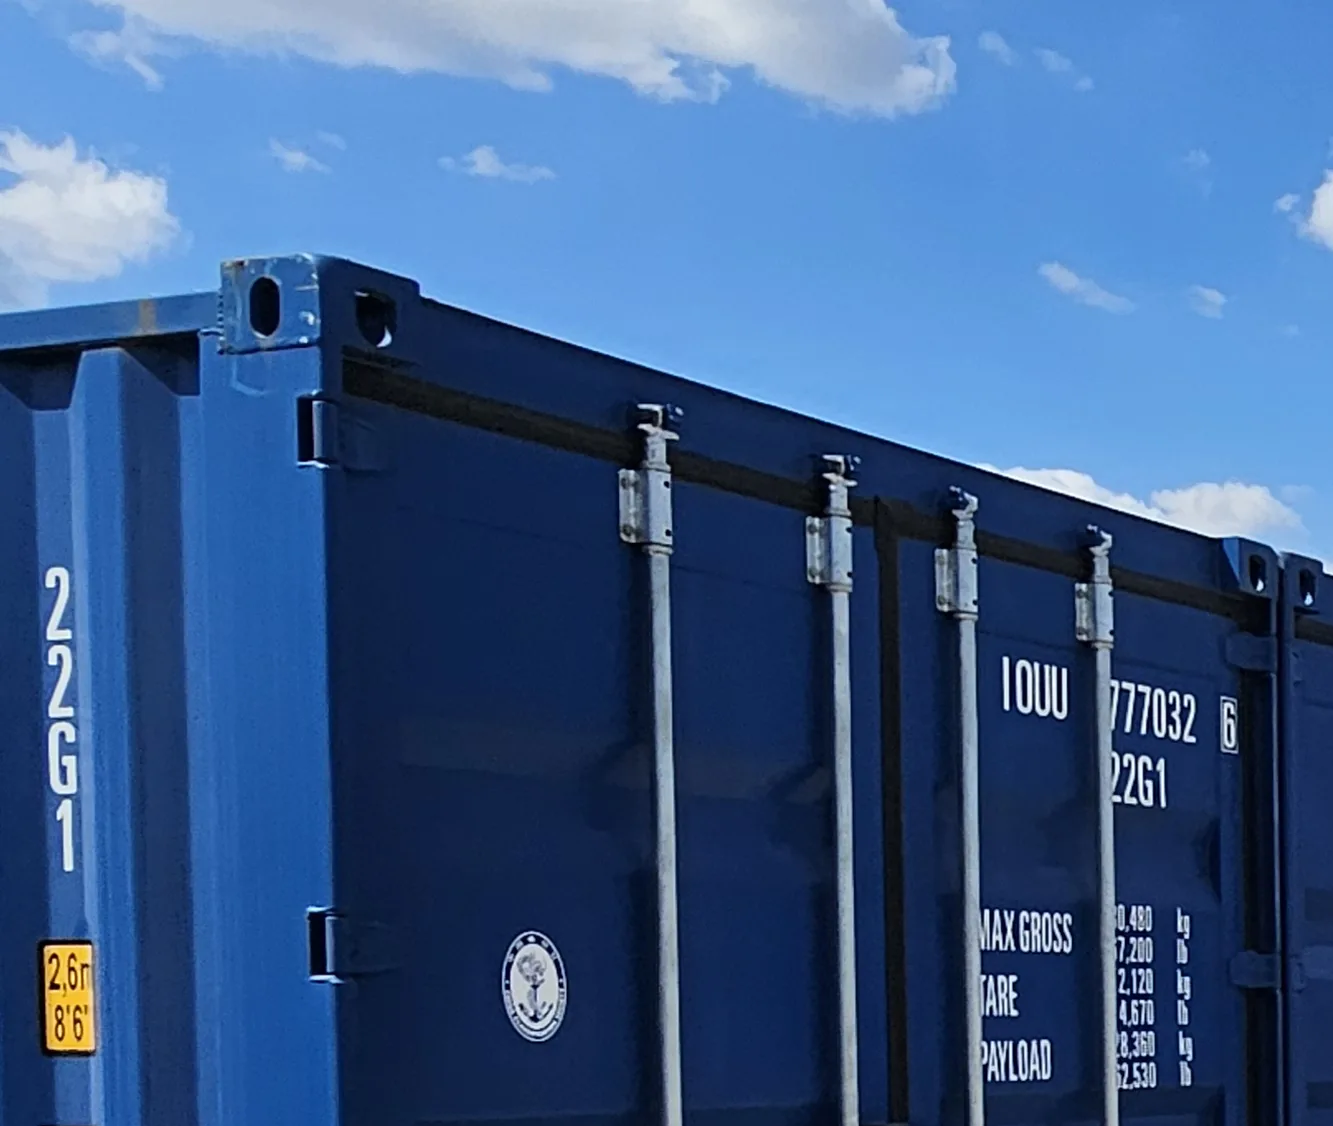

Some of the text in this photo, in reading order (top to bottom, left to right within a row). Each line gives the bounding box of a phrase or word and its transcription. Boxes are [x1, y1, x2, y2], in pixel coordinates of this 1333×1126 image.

[45, 566, 78, 872] 22G1
[1002, 656, 1237, 752] IOUU 777032 6
[1111, 751, 1167, 809] 22G1
[1019, 909, 1073, 954] GROSS
[1116, 904, 1191, 940] 0,480 kg
[1116, 936, 1154, 965] 7,200
[1176, 968, 1191, 1000] kg
[981, 1039, 1052, 1082] PAYLOAD
[1178, 1030, 1193, 1062] kg
